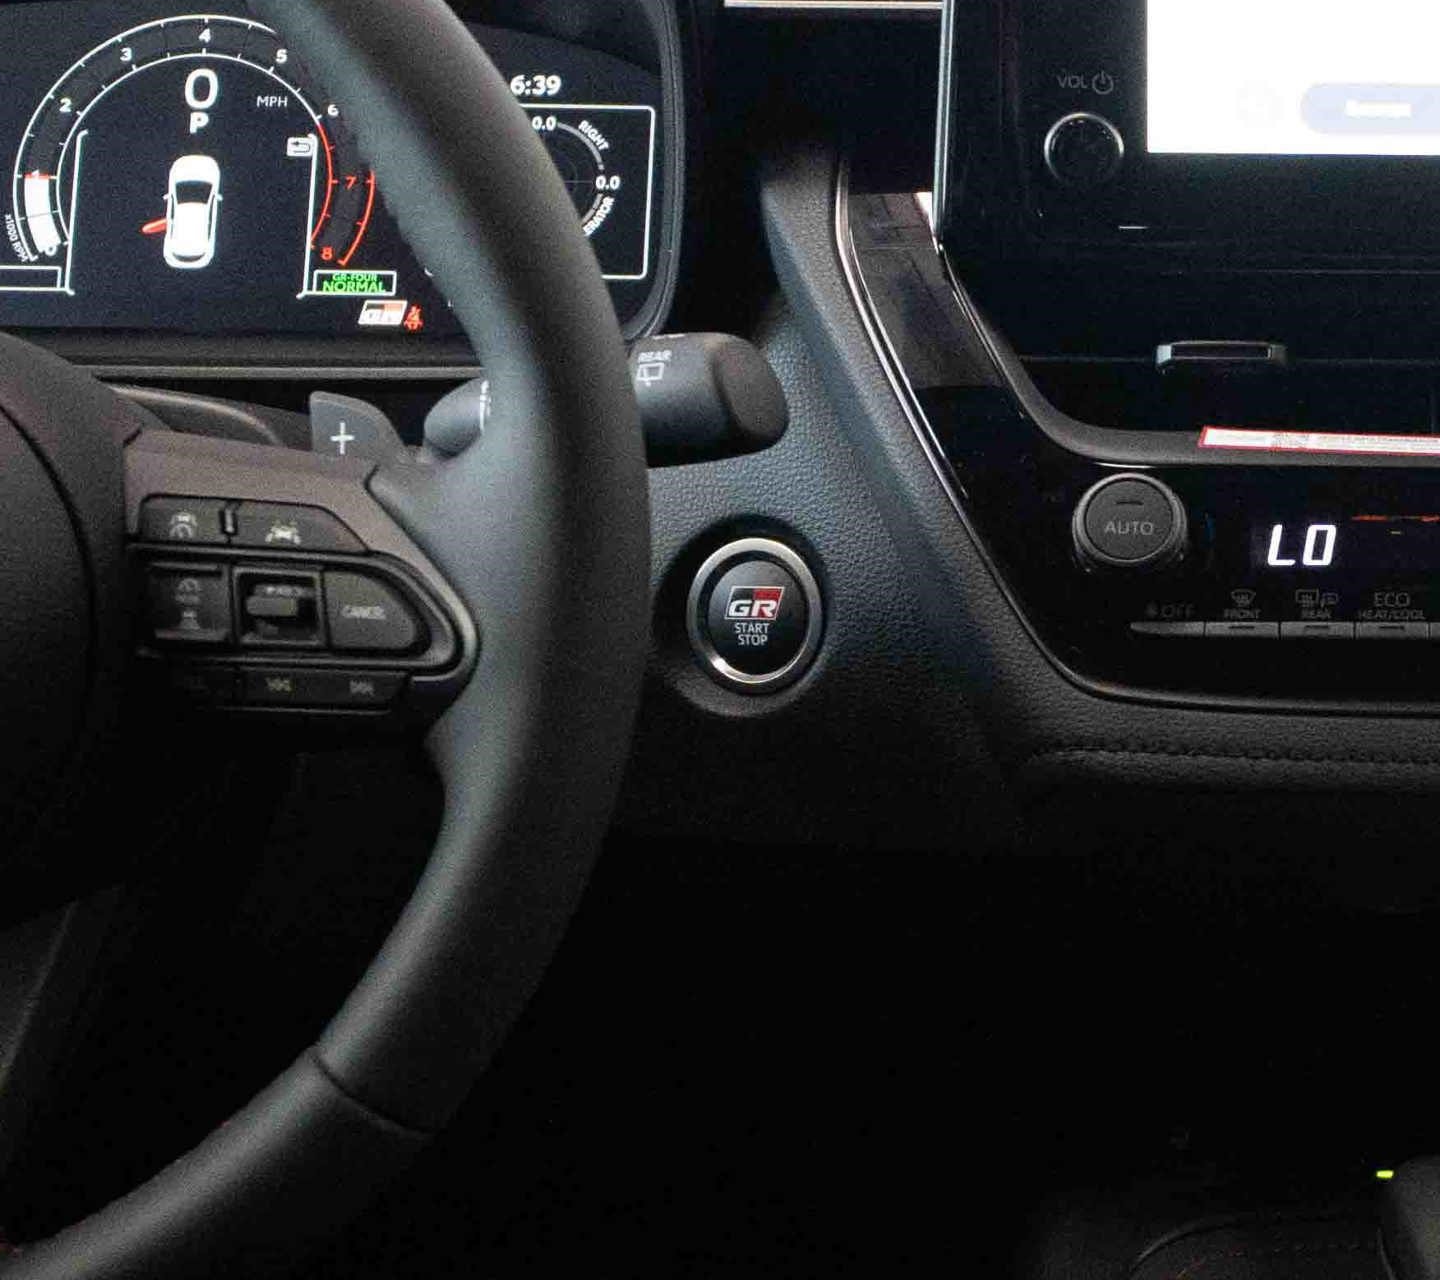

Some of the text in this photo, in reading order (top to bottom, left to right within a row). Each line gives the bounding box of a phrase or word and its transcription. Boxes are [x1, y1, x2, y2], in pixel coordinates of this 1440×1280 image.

[197, 28, 211, 43] 4
[120, 48, 133, 62] 3
[276, 49, 288, 64] 5
[184, 68, 219, 110] 0
[510, 74, 562, 96] 6:39
[1057, 74, 1088, 89] VOL
[59, 98, 72, 112] 2
[256, 94, 288, 108] MPH
[328, 103, 340, 118] 6
[189, 112, 209, 134] P
[531, 116, 557, 131] 0.0
[578, 119, 610, 153] RIGHT
[345, 177, 356, 190] 7
[596, 175, 621, 191] 0.0
[321, 247, 334, 262] 8
[322, 281, 387, 293] NORMAL
[1103, 520, 1155, 536] AUTO
[1267, 523, 1337, 567] LO
[1373, 591, 1410, 607] ECO
[734, 622, 770, 634] START
[737, 634, 768, 646] STOP
